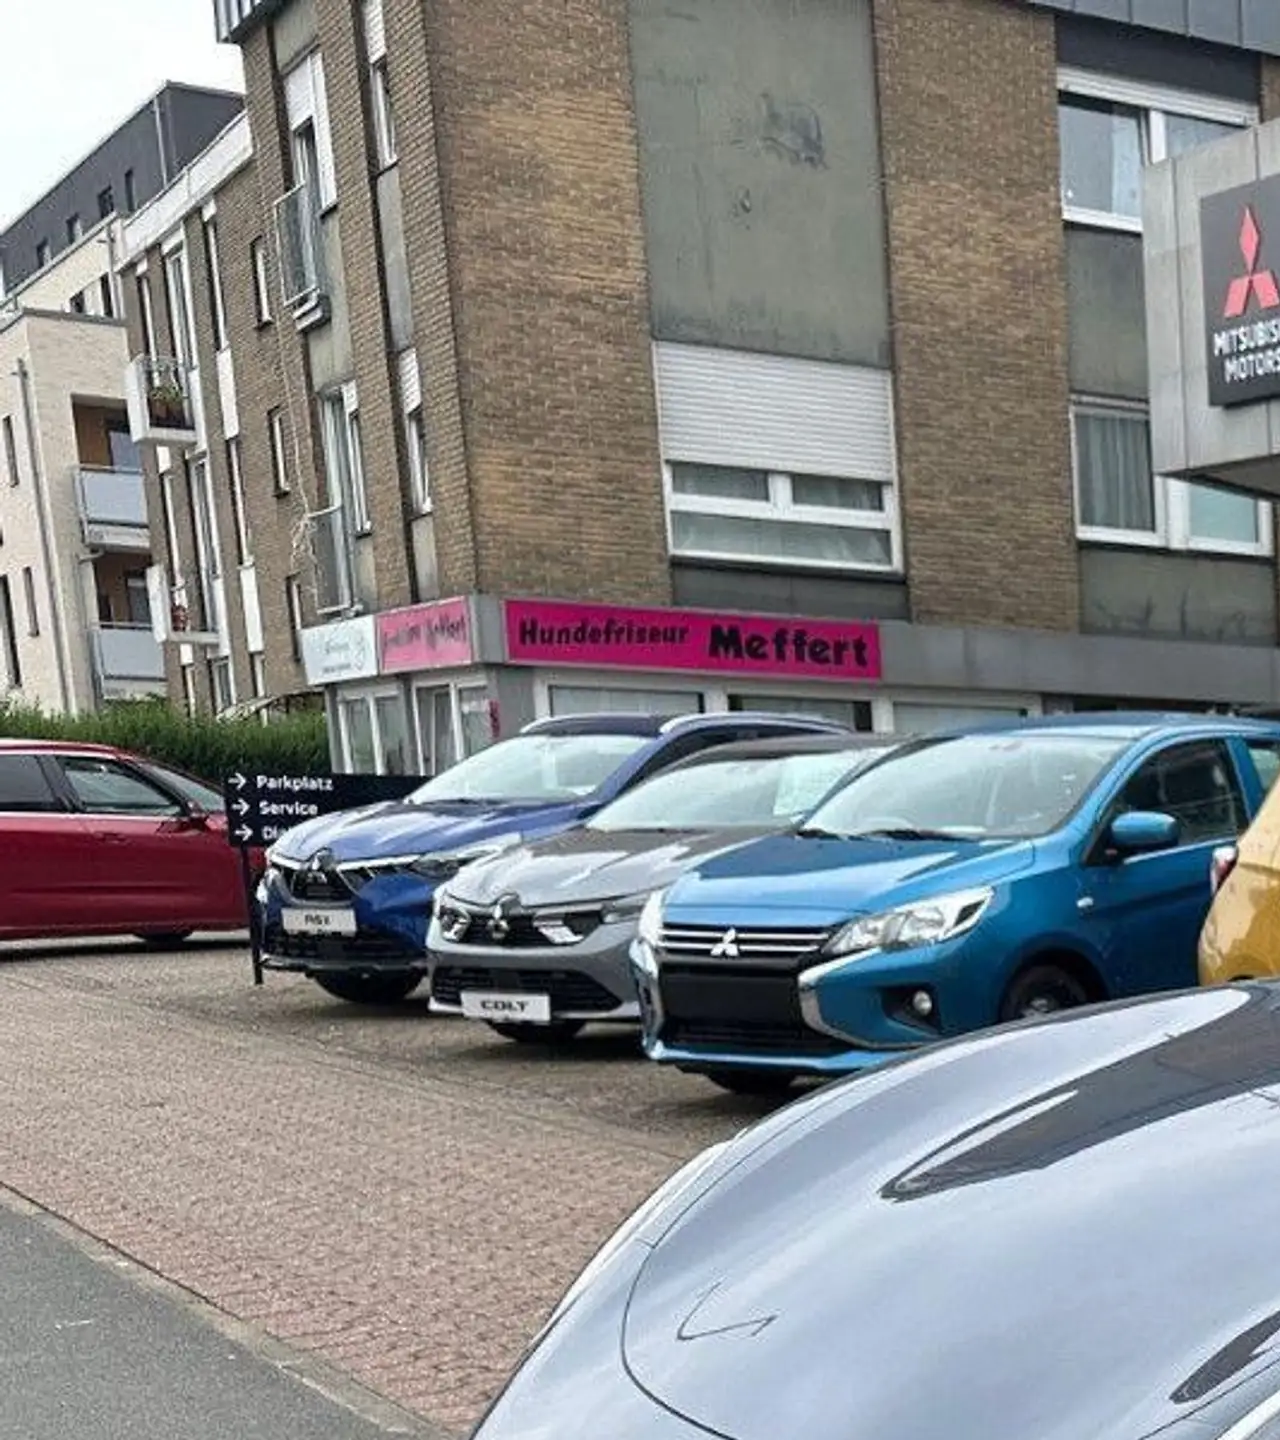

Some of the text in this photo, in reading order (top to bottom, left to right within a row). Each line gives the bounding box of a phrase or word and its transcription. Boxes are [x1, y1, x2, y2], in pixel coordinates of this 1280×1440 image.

[519, 618, 868, 667] Hundefriseur Meffert
[256, 774, 334, 791] Parkplatz
[259, 801, 319, 816] Service
[481, 1001, 526, 1012] COLT
